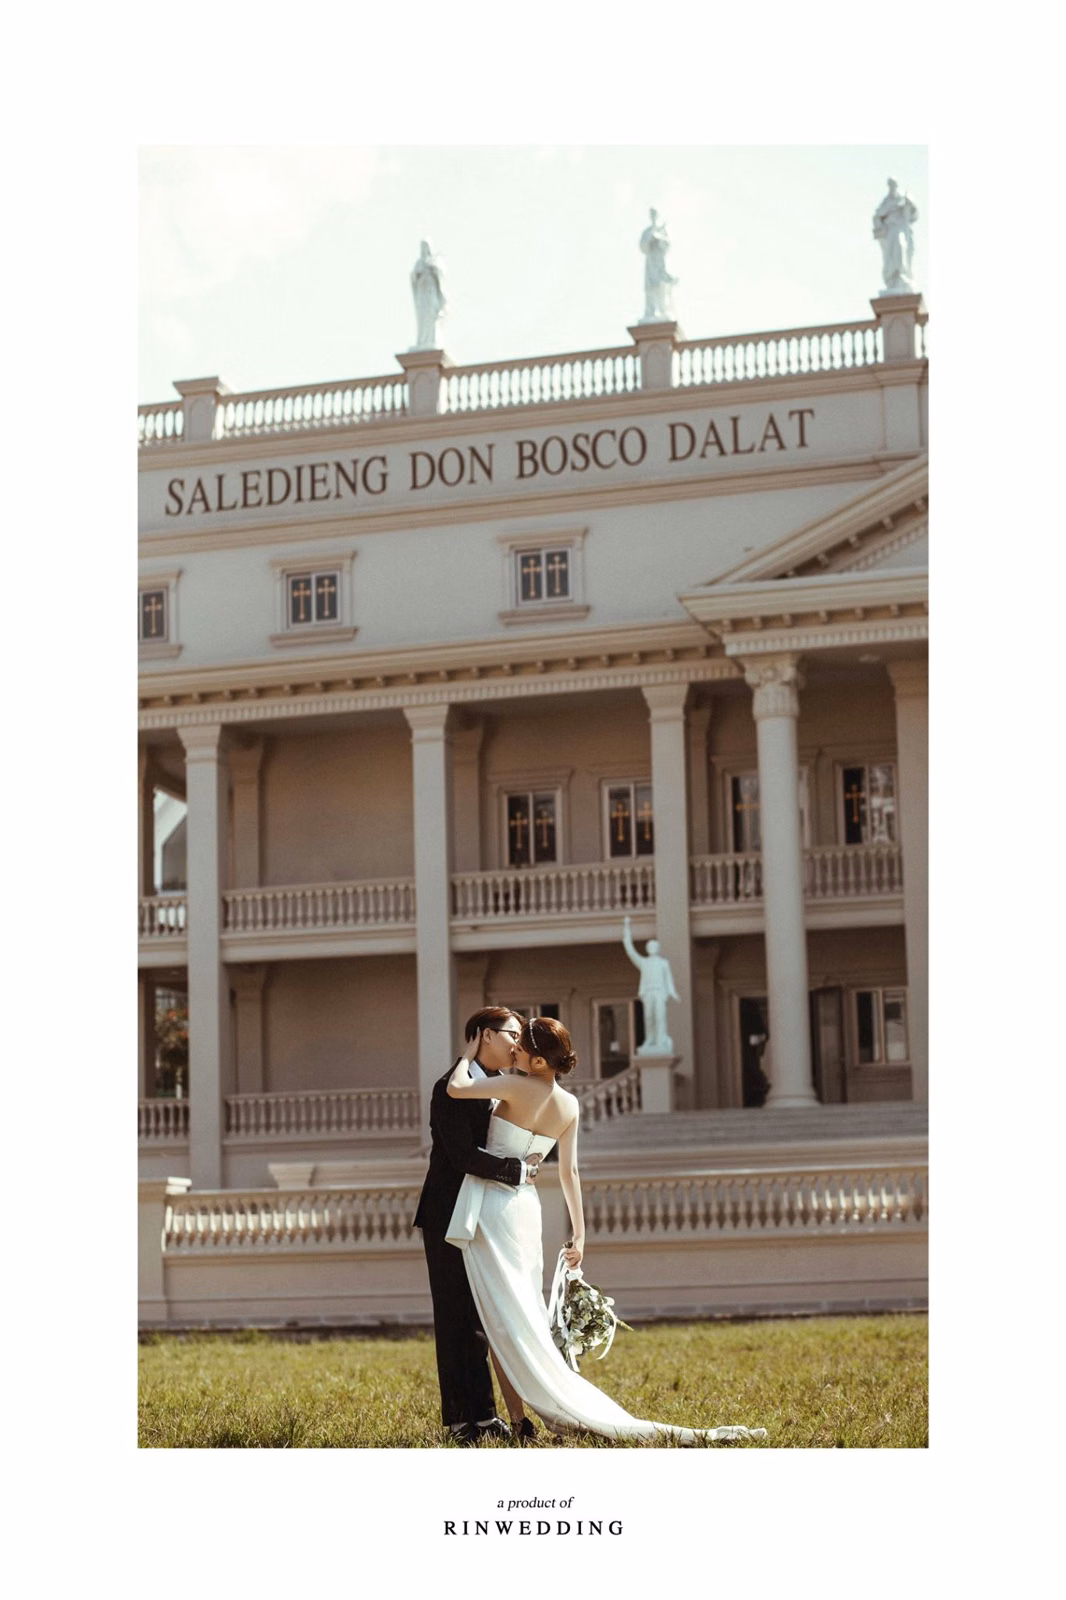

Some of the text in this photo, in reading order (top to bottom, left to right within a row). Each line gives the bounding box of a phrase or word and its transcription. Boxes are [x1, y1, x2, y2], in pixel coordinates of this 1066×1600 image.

[165, 409, 815, 517] SALEDIENG DON BOSCO DALAT
